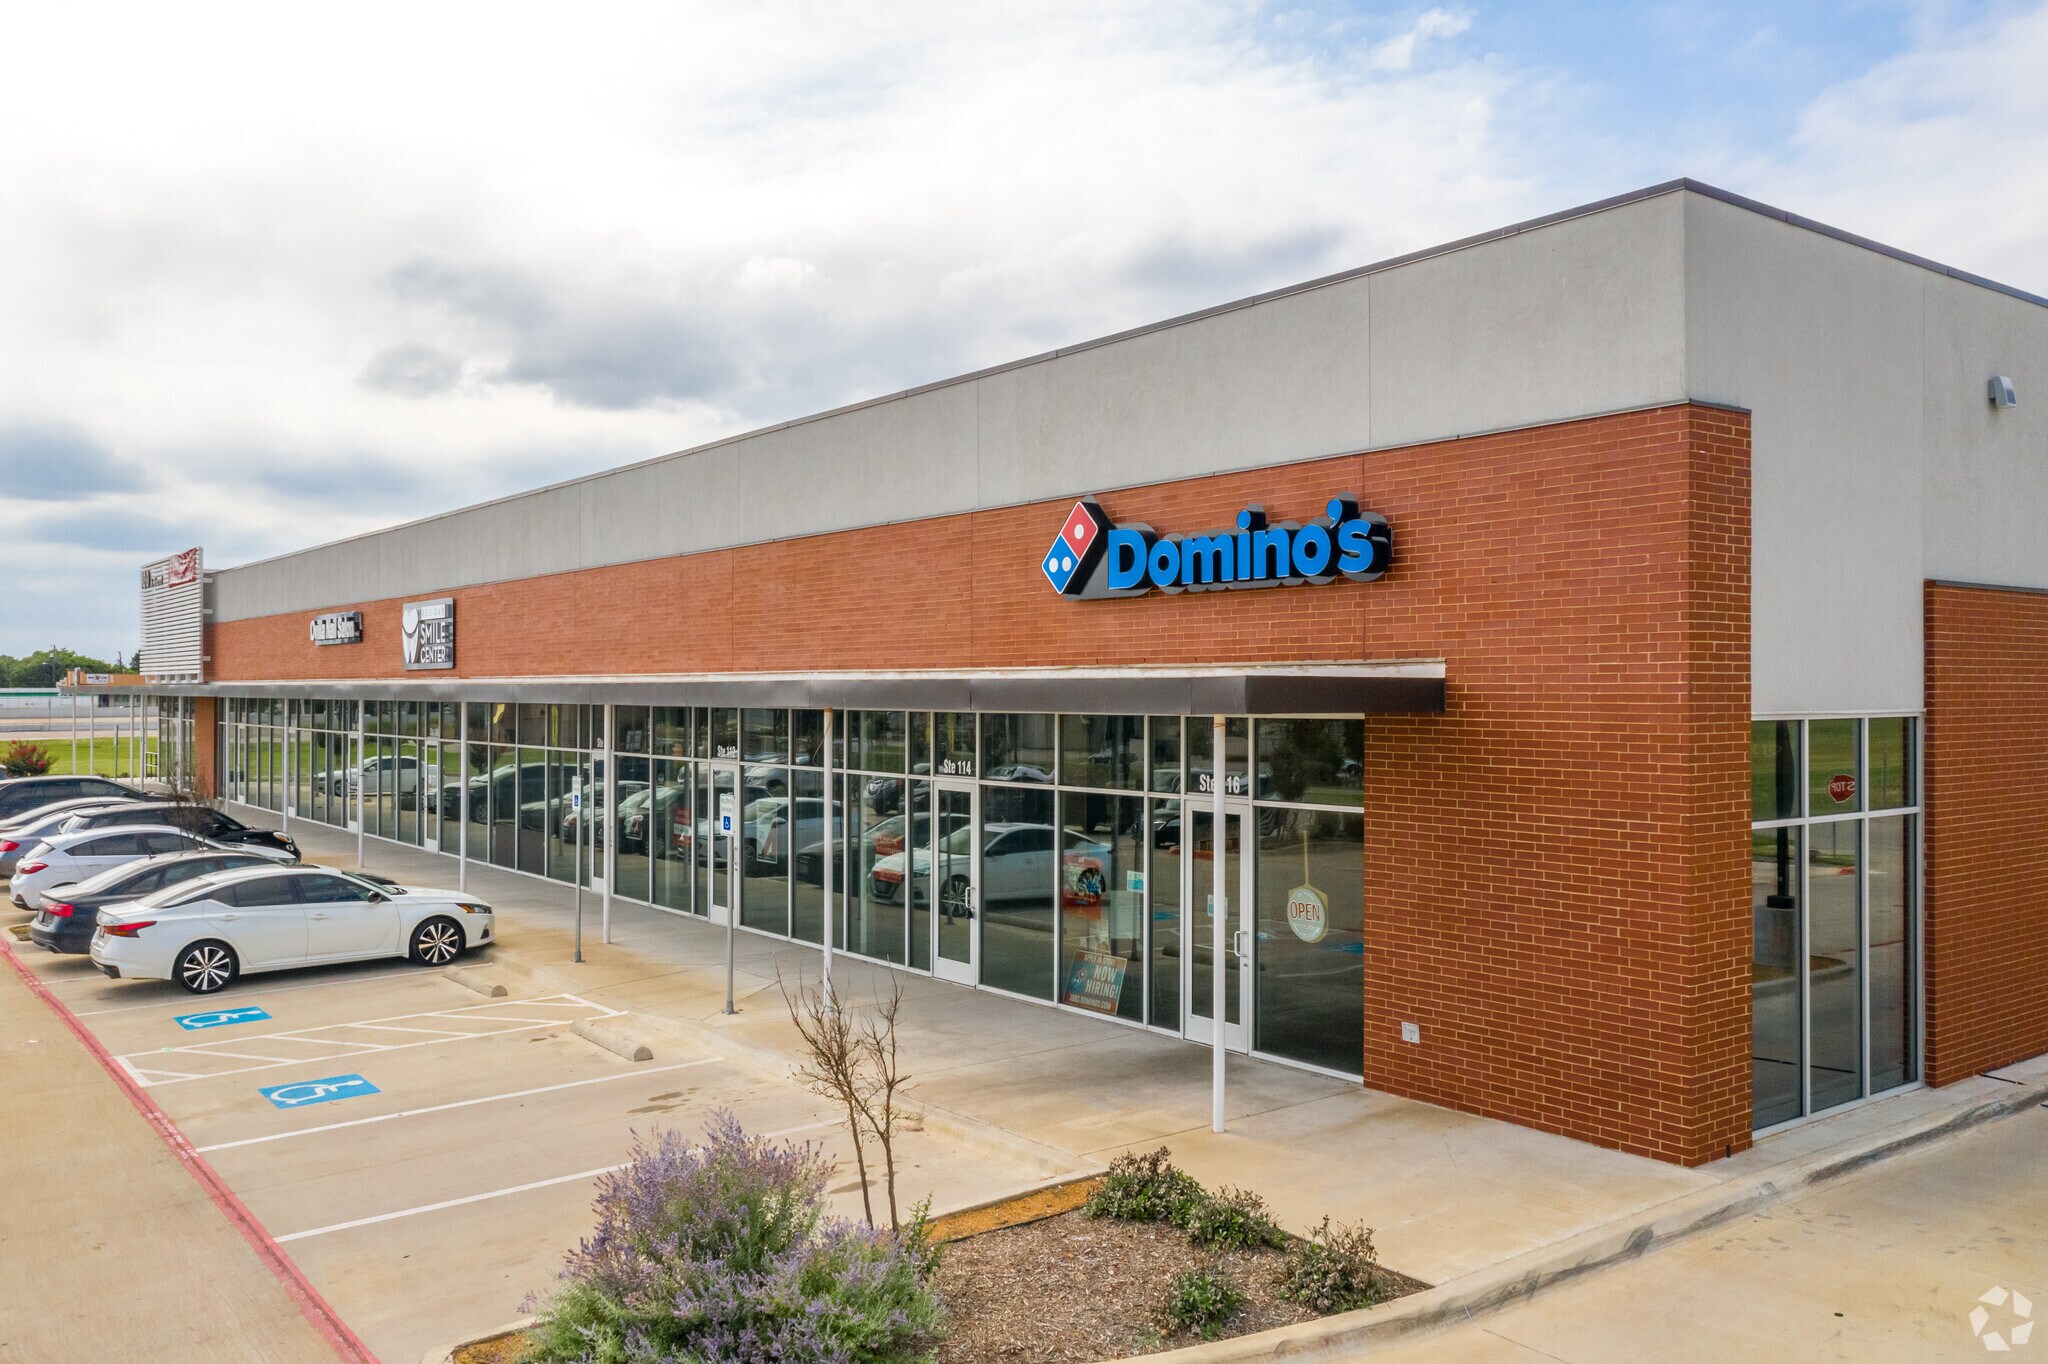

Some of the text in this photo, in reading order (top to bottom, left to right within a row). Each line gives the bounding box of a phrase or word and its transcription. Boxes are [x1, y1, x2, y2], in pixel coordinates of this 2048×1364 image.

[1108, 497, 1374, 590] Domino's
[420, 621, 446, 645] SMILE
[420, 645, 446, 663] CENTER
[943, 758, 972, 775] Ste 114
[1199, 773, 1214, 791] Ste
[1291, 901, 1320, 922] OPEN
[1093, 964, 1118, 983] NOW
[1085, 980, 1119, 998] HIRING!
